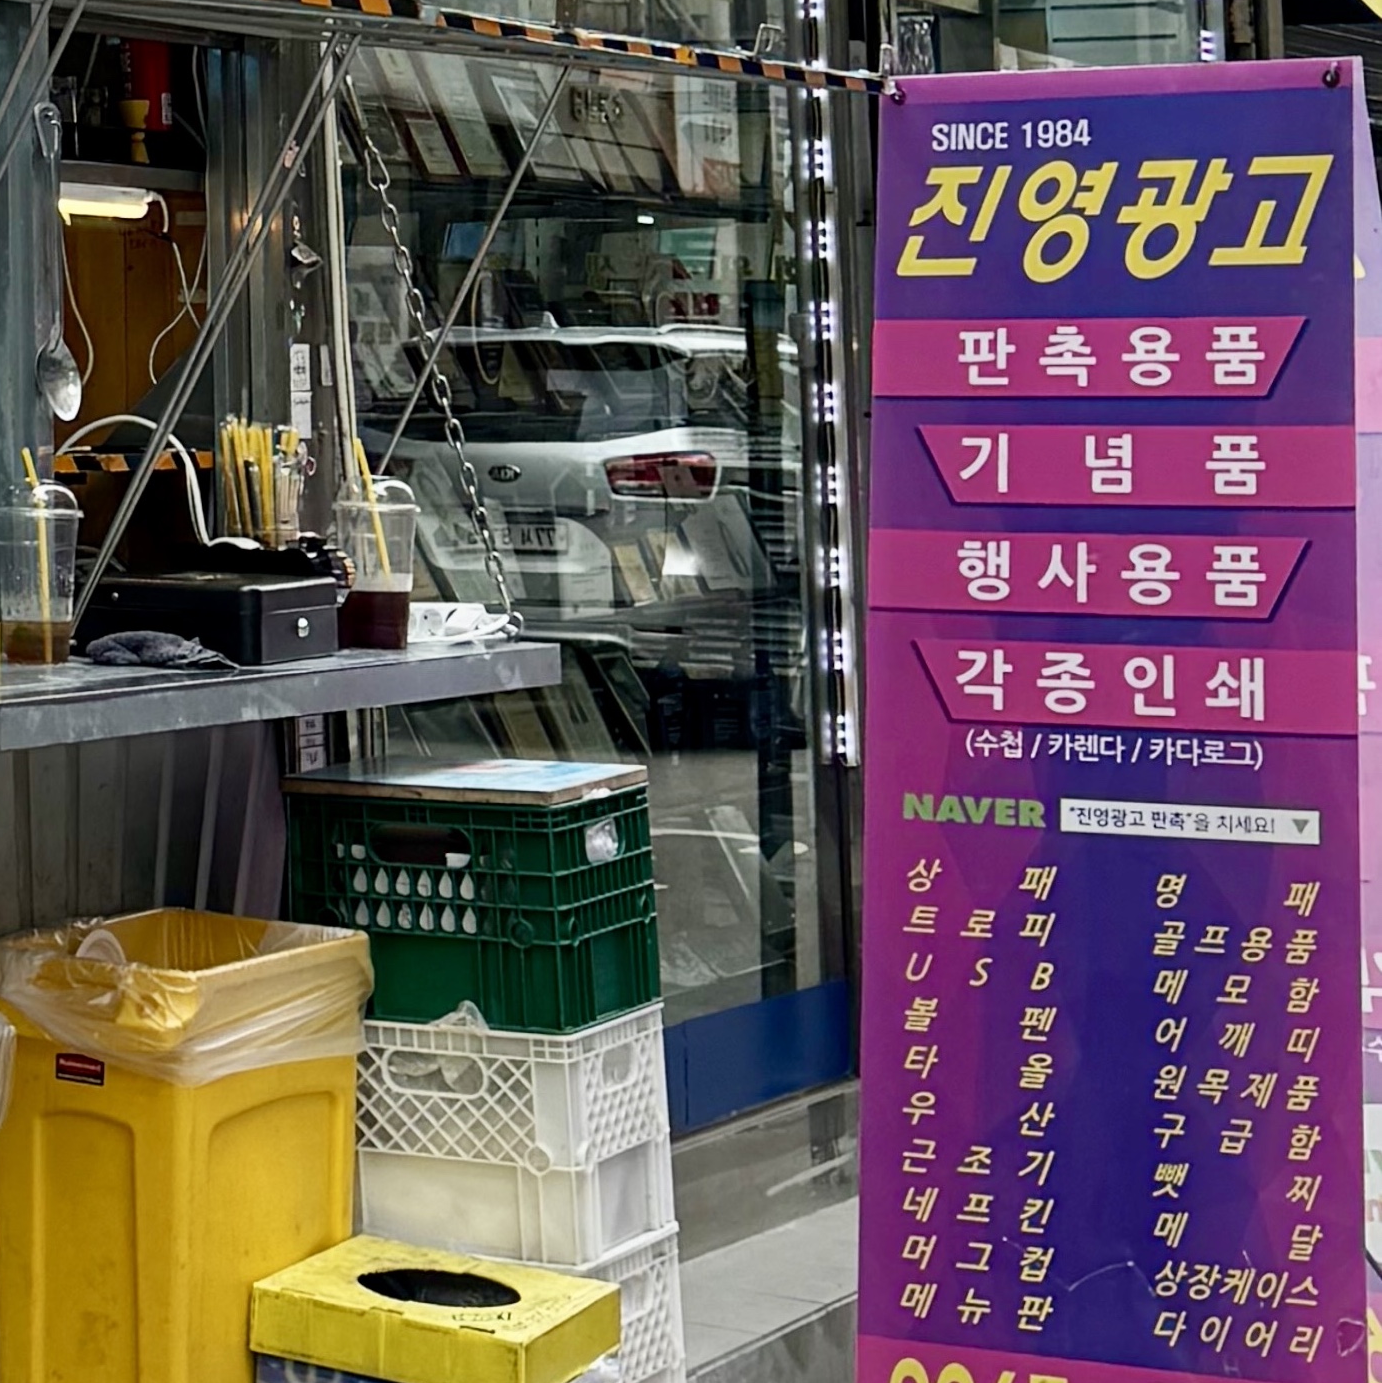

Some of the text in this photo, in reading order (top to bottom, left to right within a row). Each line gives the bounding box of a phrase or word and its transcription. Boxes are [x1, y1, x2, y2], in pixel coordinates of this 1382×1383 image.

[930, 117, 1092, 152] SINCE 1984
[895, 153, 1335, 285] 진영광고
[957, 325, 1266, 387] 판촉용품
[956, 538, 1267, 607] 행사용품
[954, 648, 1266, 721] 각종인쇄
[1048, 733, 1126, 764] 카렌다
[902, 792, 1046, 828] NAVER
[1216, 813, 1275, 836] 치세요!
[1153, 920, 1318, 967] 골프용품
[1152, 1063, 1321, 1112] 원목제품
[1152, 1259, 1321, 1309] 상장케이스
[1152, 1309, 1324, 1362] 다이어리
